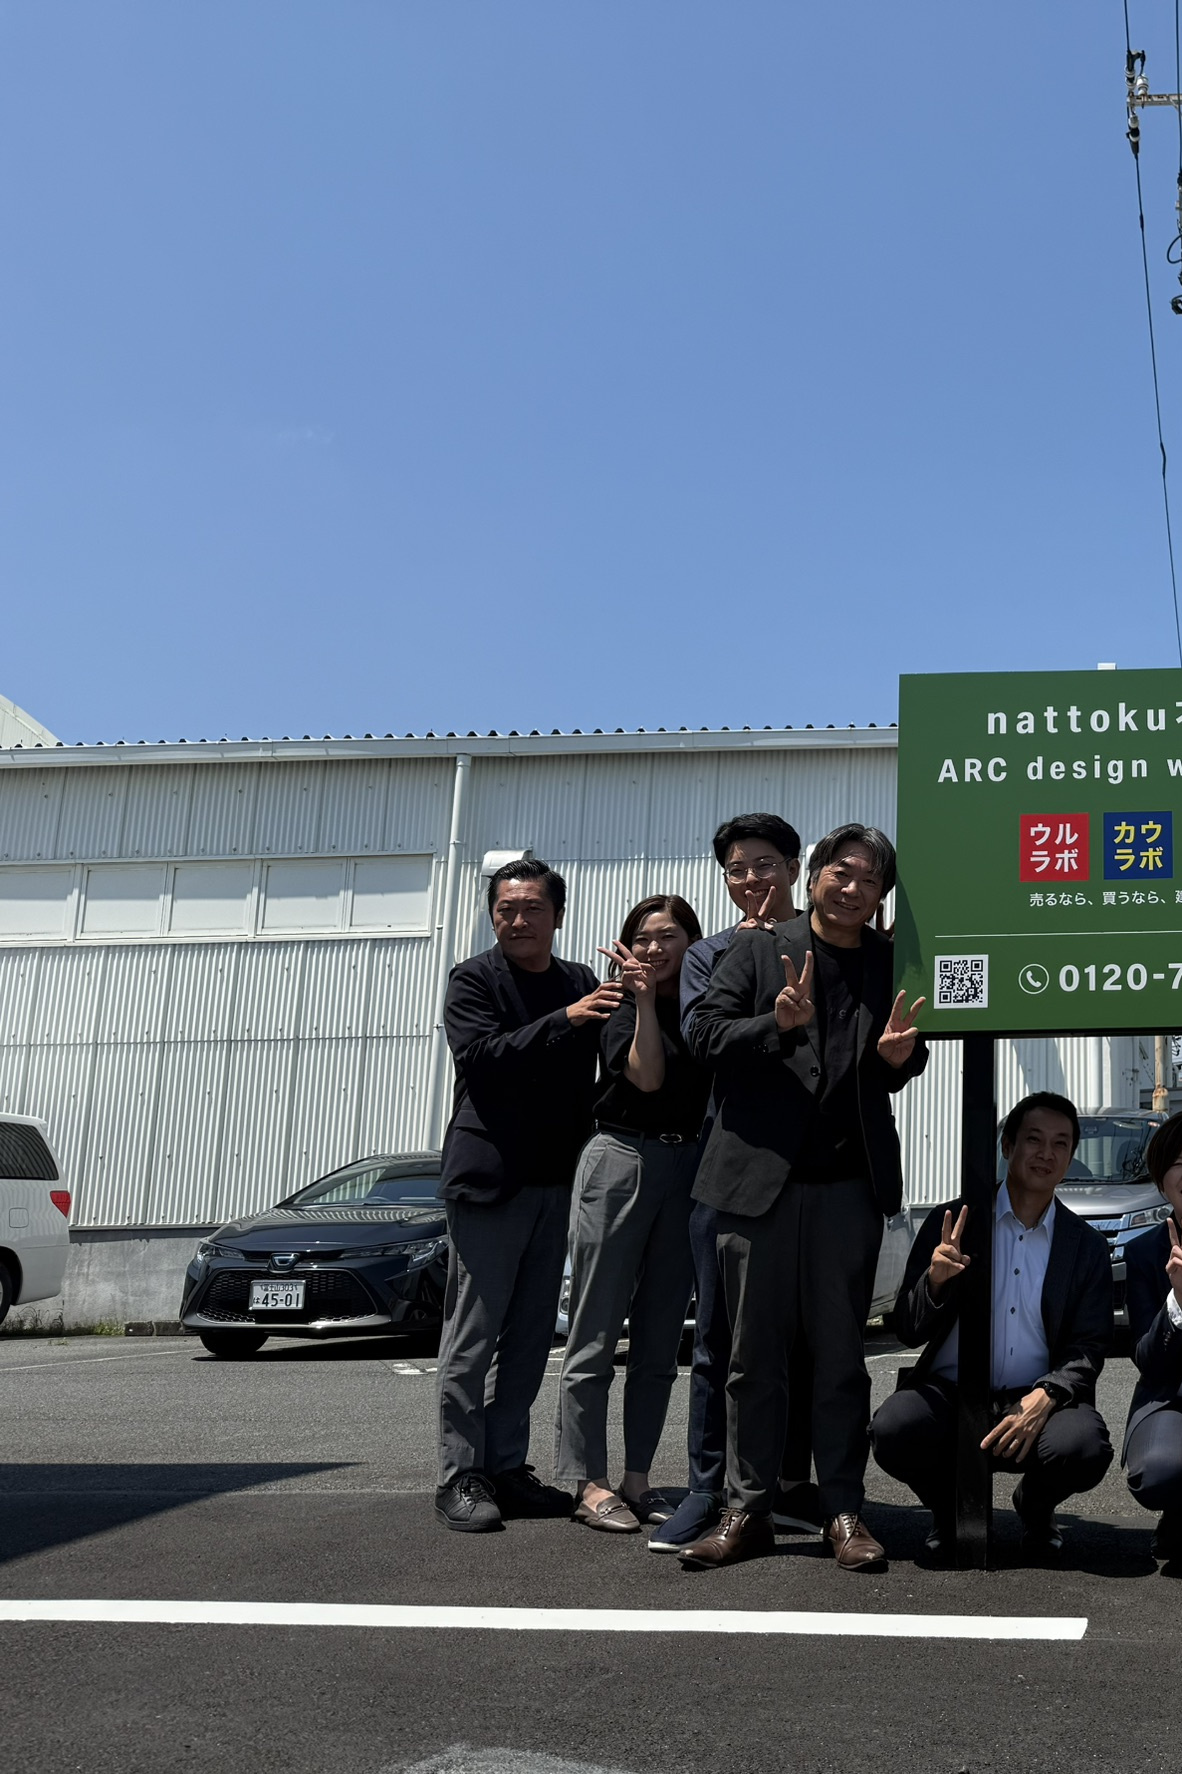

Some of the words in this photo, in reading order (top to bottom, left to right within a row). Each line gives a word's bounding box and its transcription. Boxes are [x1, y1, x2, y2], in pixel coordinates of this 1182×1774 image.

[937, 757, 1007, 783] ARC
[1026, 755, 1148, 785] design
[1030, 823, 1079, 846] ウル
[1113, 820, 1162, 844] カウ
[1030, 848, 1079, 873] ラボ
[1114, 846, 1164, 871] ラボ
[261, 1292, 300, 1307] 45-01
